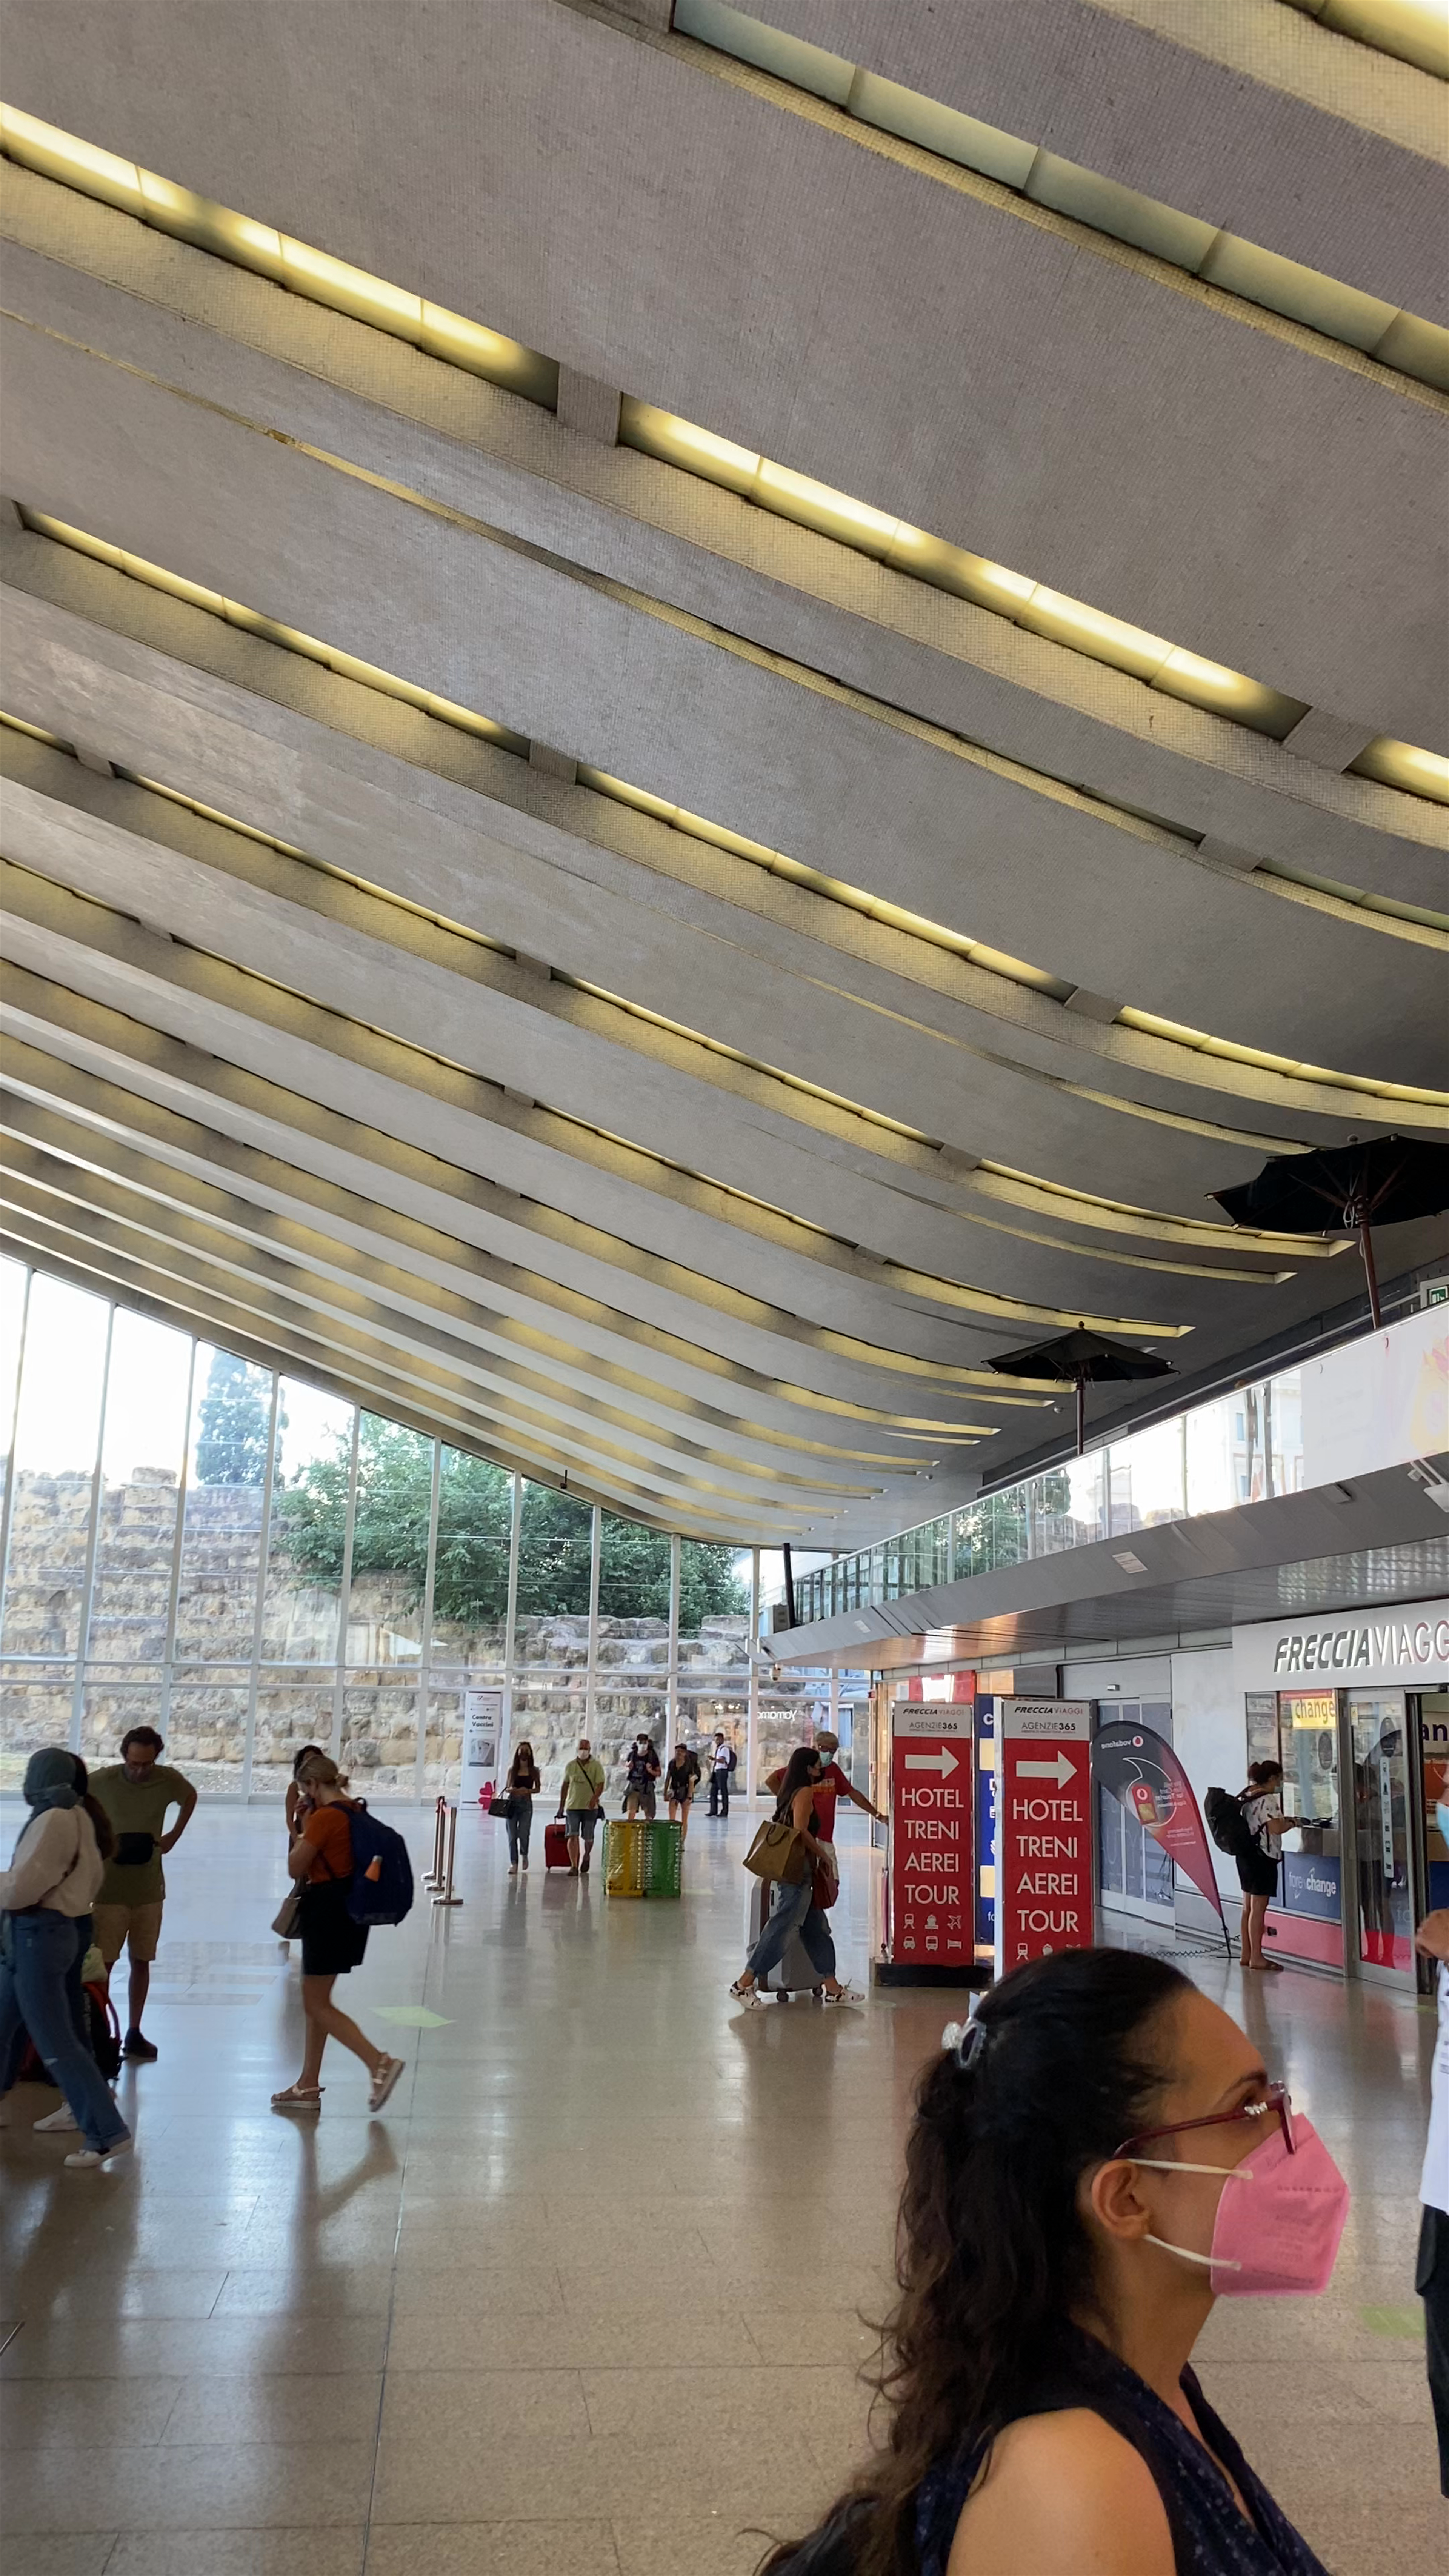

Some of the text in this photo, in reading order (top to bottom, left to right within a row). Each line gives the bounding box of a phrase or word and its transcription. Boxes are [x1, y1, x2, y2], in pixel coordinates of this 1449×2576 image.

[1295, 1699, 1335, 1724] change
[1021, 1722, 1076, 1730] AGENZIE365
[902, 1787, 964, 1808] HOTEL
[1013, 1799, 1083, 1822] HOTEL
[904, 1820, 959, 1840] TRENI
[1016, 1836, 1078, 1858] TRENI
[904, 1852, 959, 1872] AEREI
[1017, 1872, 1078, 1895] AEREI
[904, 1885, 960, 1904] TOUR
[1017, 1910, 1079, 1932] TOUR
